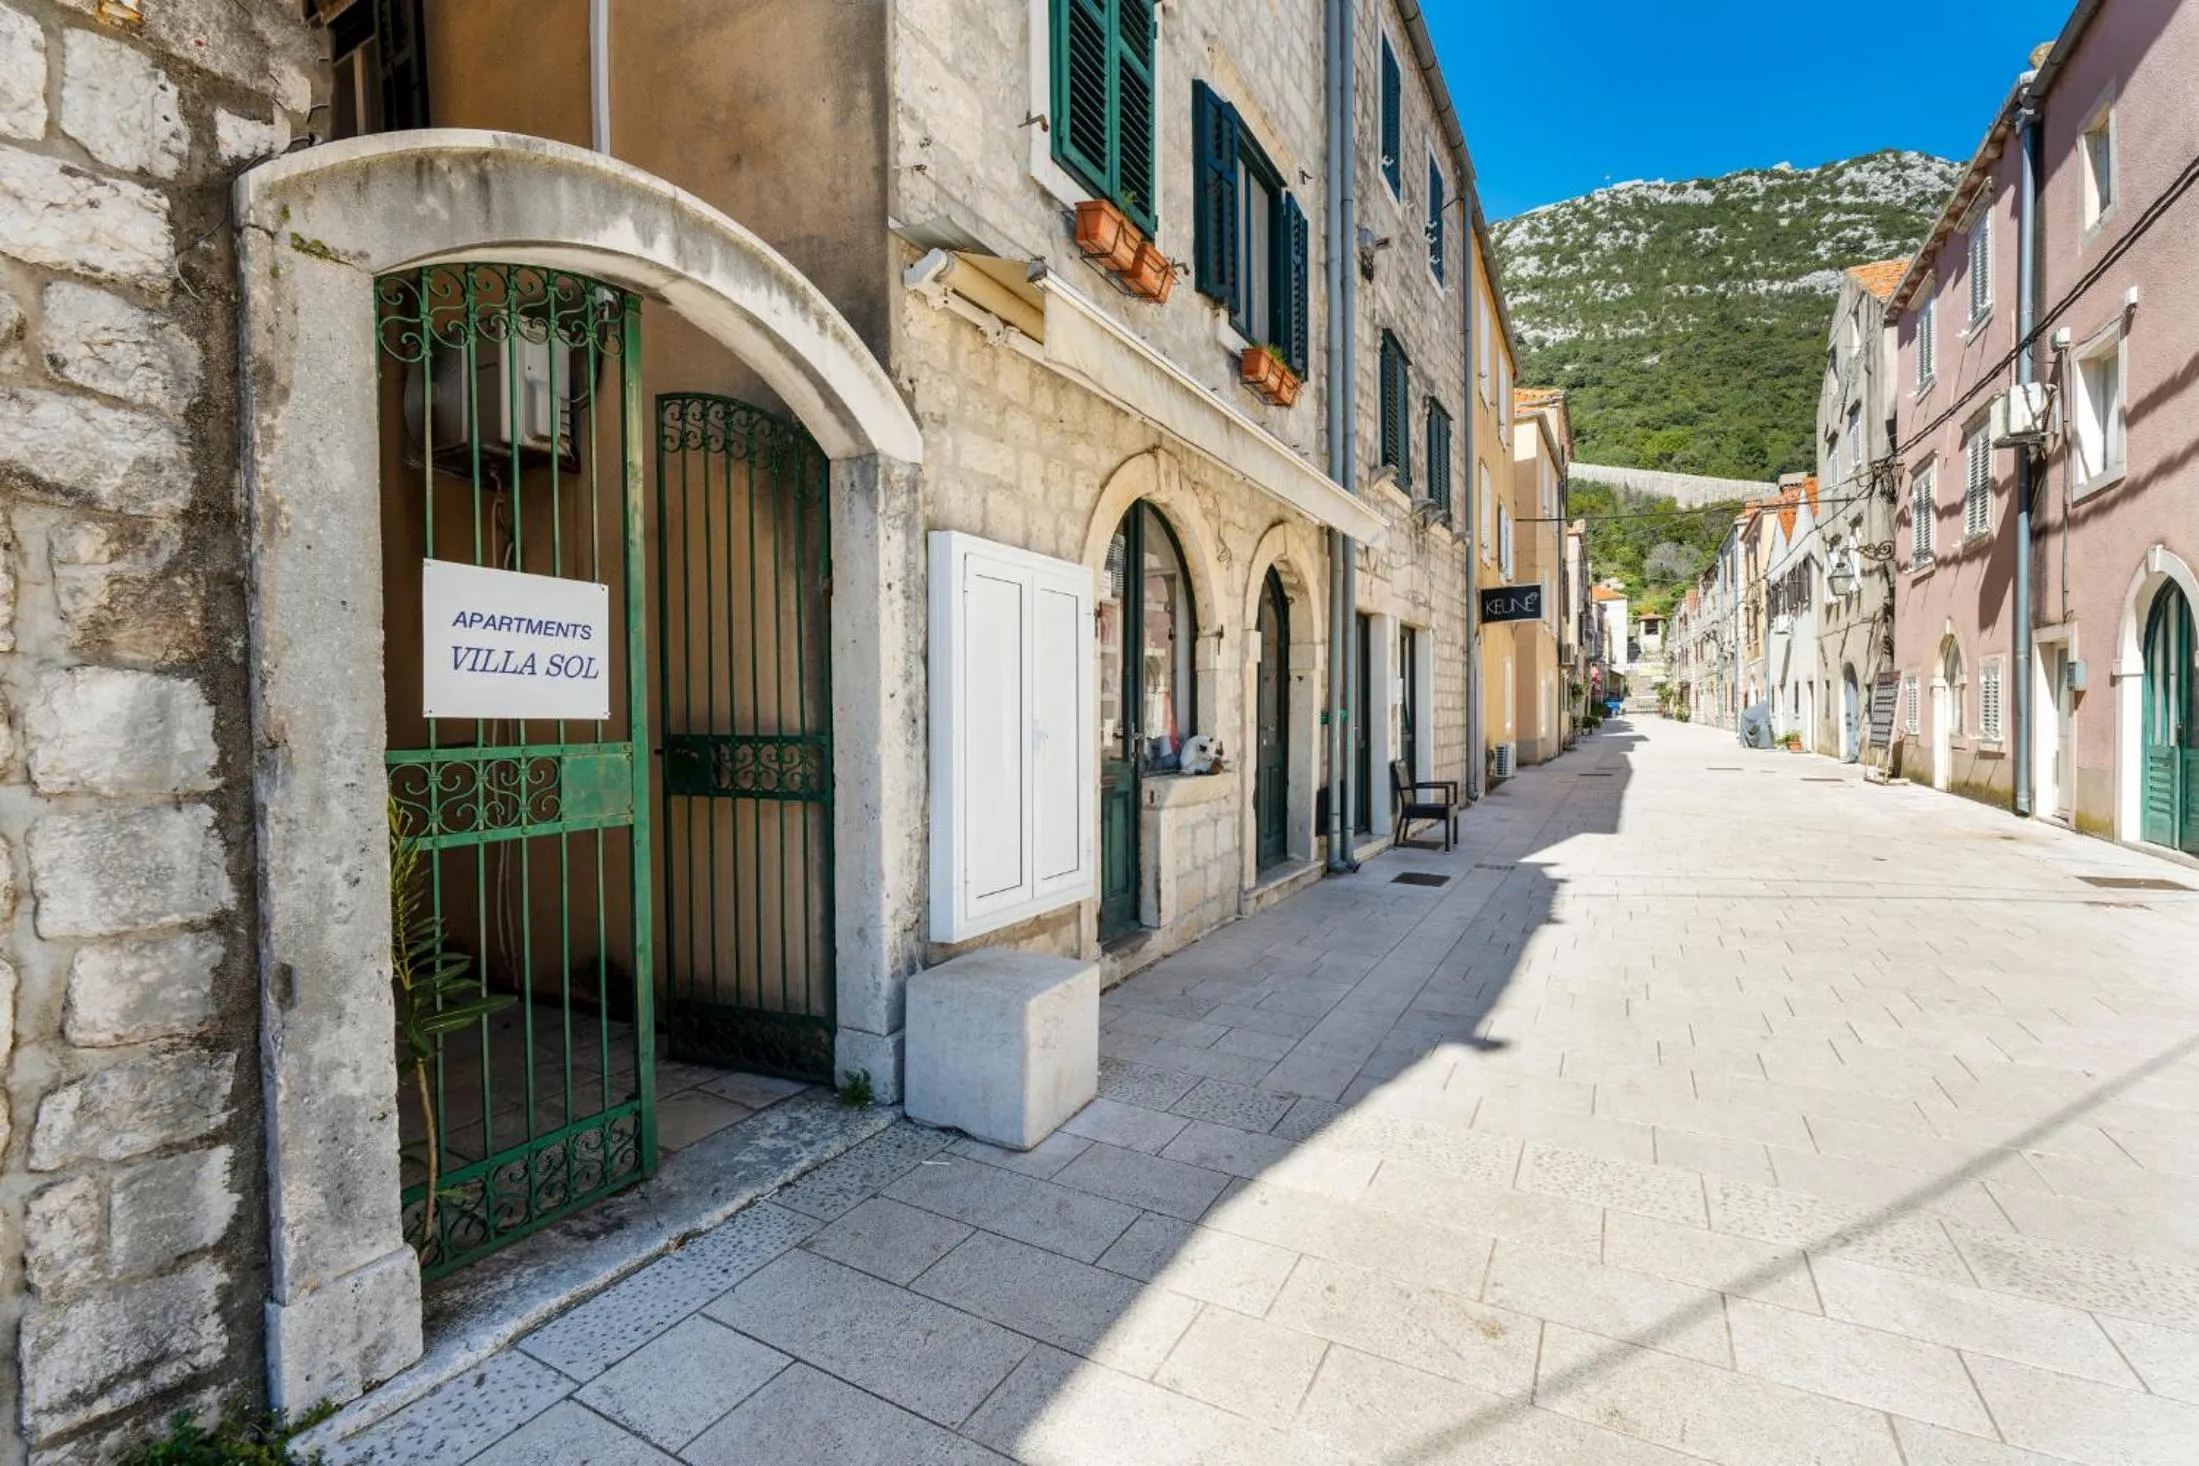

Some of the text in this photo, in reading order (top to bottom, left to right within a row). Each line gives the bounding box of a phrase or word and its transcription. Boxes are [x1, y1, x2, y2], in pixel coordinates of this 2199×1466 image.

[452, 611, 592, 640] APARTMENTS
[451, 646, 599, 680] VILLA SOL
